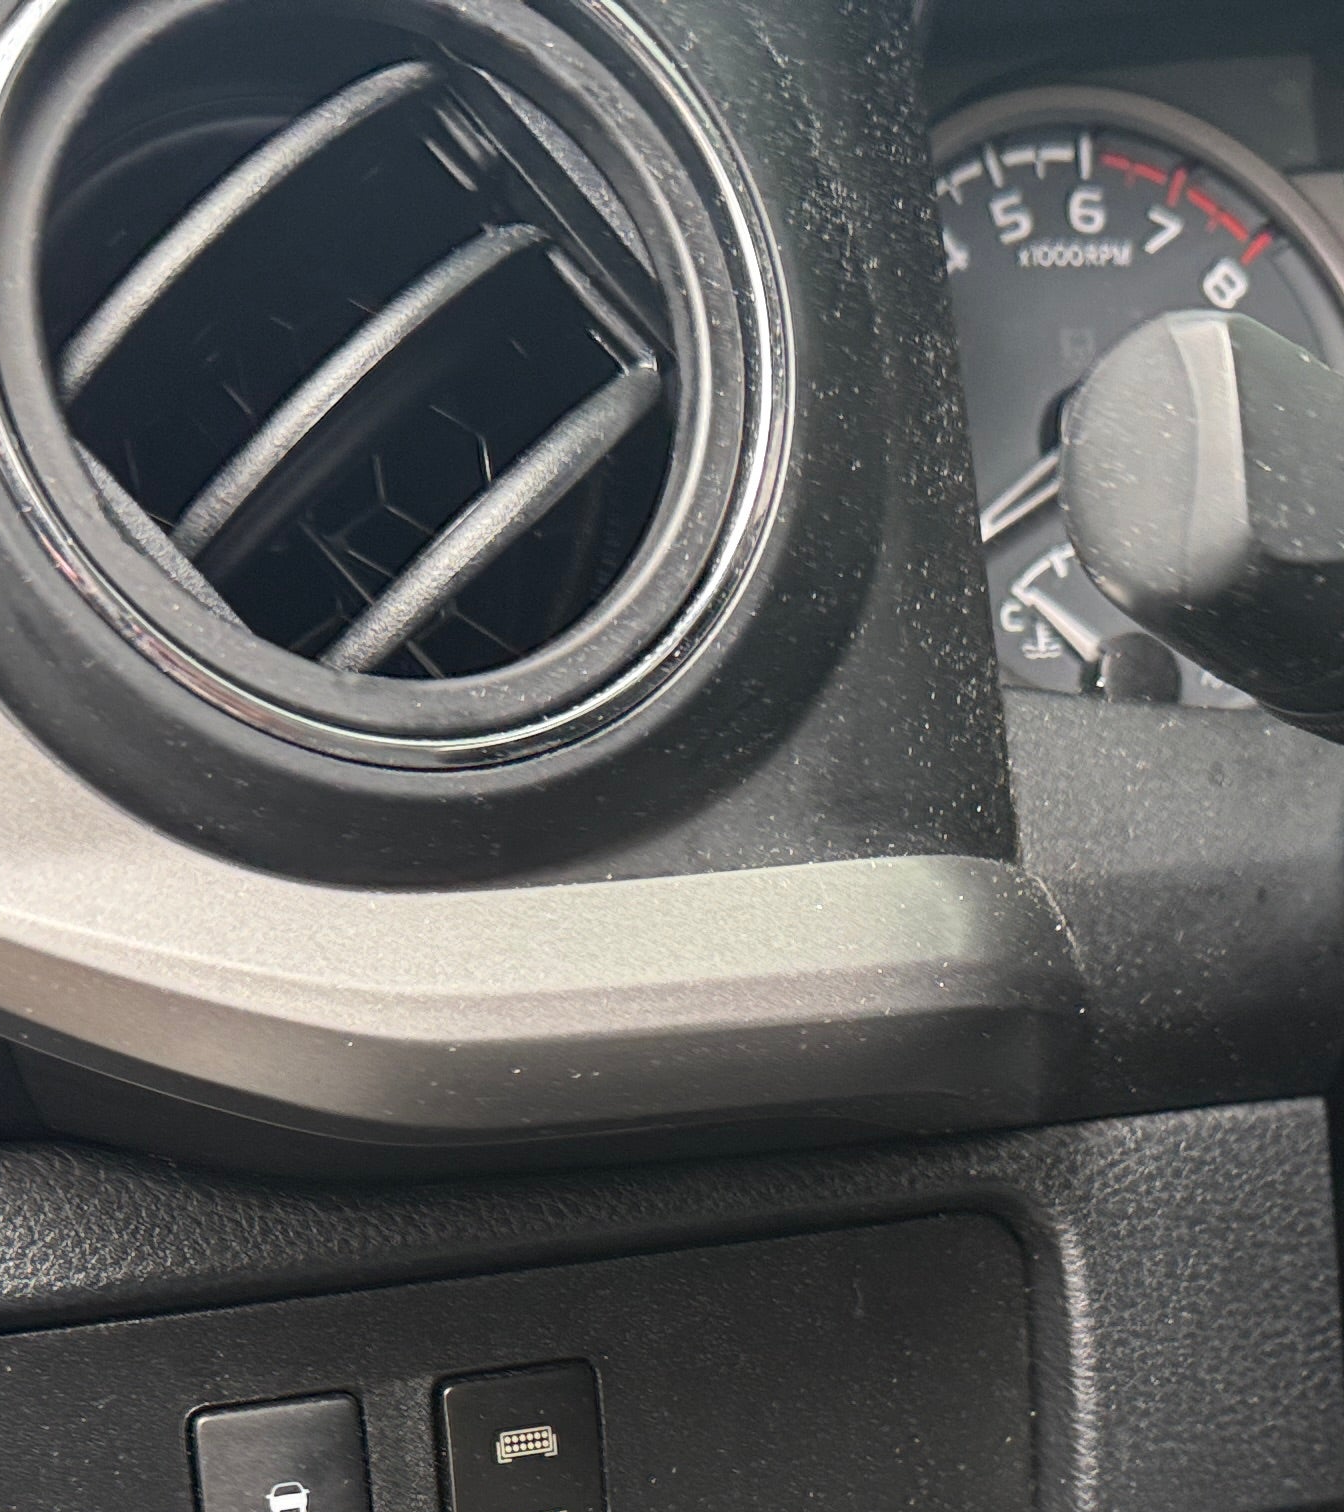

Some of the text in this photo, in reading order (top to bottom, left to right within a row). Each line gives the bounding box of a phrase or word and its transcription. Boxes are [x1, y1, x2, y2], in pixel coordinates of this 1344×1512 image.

[989, 190, 1032, 243] 5
[1067, 186, 1105, 233] 6
[1144, 206, 1183, 254] 7
[1203, 257, 1248, 309] 8
[1000, 601, 1025, 632] C
